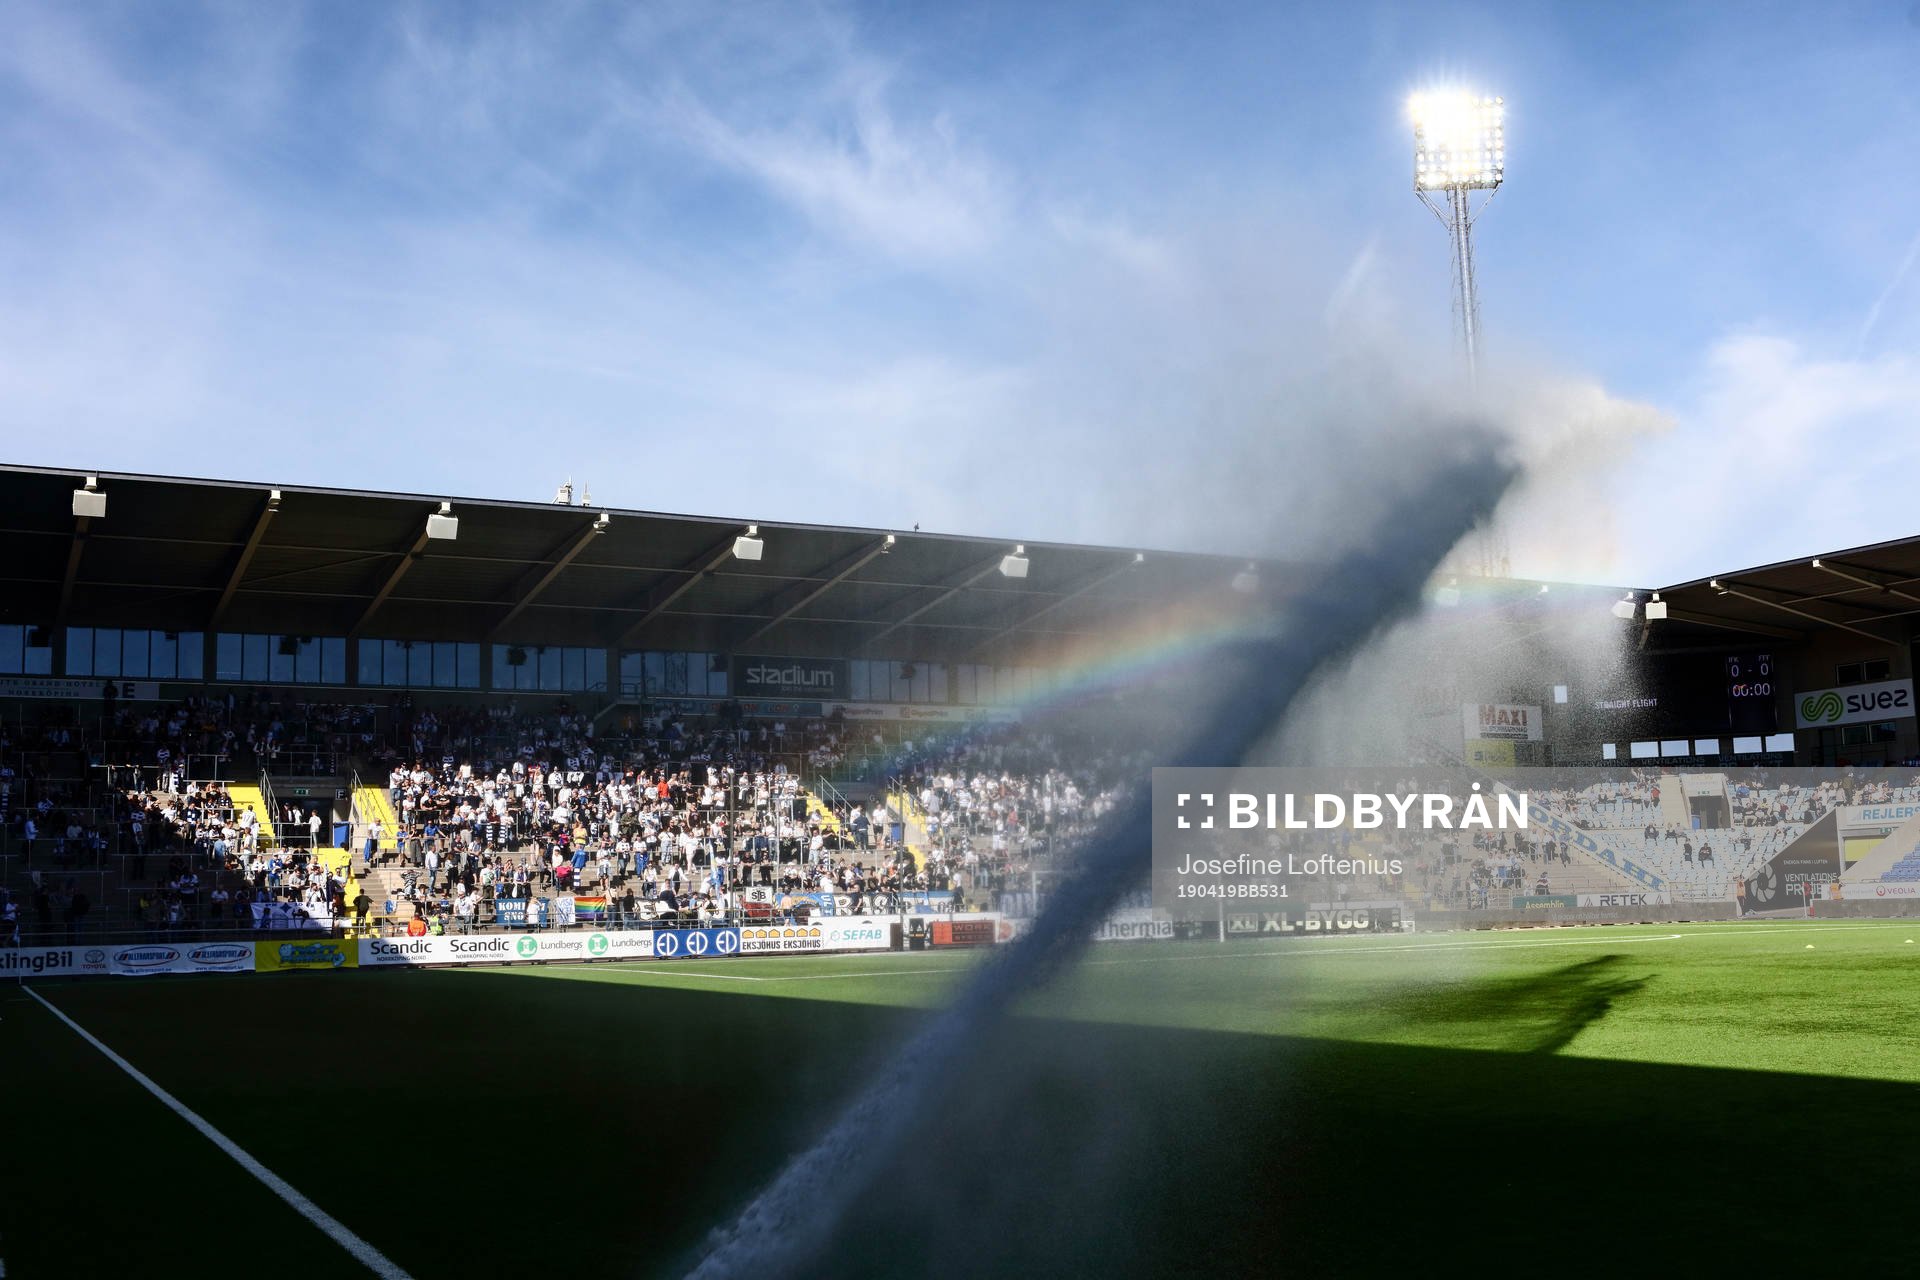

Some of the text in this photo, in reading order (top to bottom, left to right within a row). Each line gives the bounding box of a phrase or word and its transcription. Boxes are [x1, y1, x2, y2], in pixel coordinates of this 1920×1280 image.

[746, 664, 834, 687] stadium
[1731, 664, 1739, 677] 0
[1760, 663, 1768, 675] 0
[1632, 699, 1657, 708] FLIGHT
[1847, 689, 1908, 713] suez
[1784, 873, 1837, 882] VENTILATIONS
[1600, 894, 1647, 907] RETEK
[842, 929, 883, 941] SEFAB
[370, 940, 433, 956] Scandic
[450, 939, 510, 953] Scandic
[540, 940, 583, 951] Lundbergs
[611, 937, 652, 949] Lundbergs
